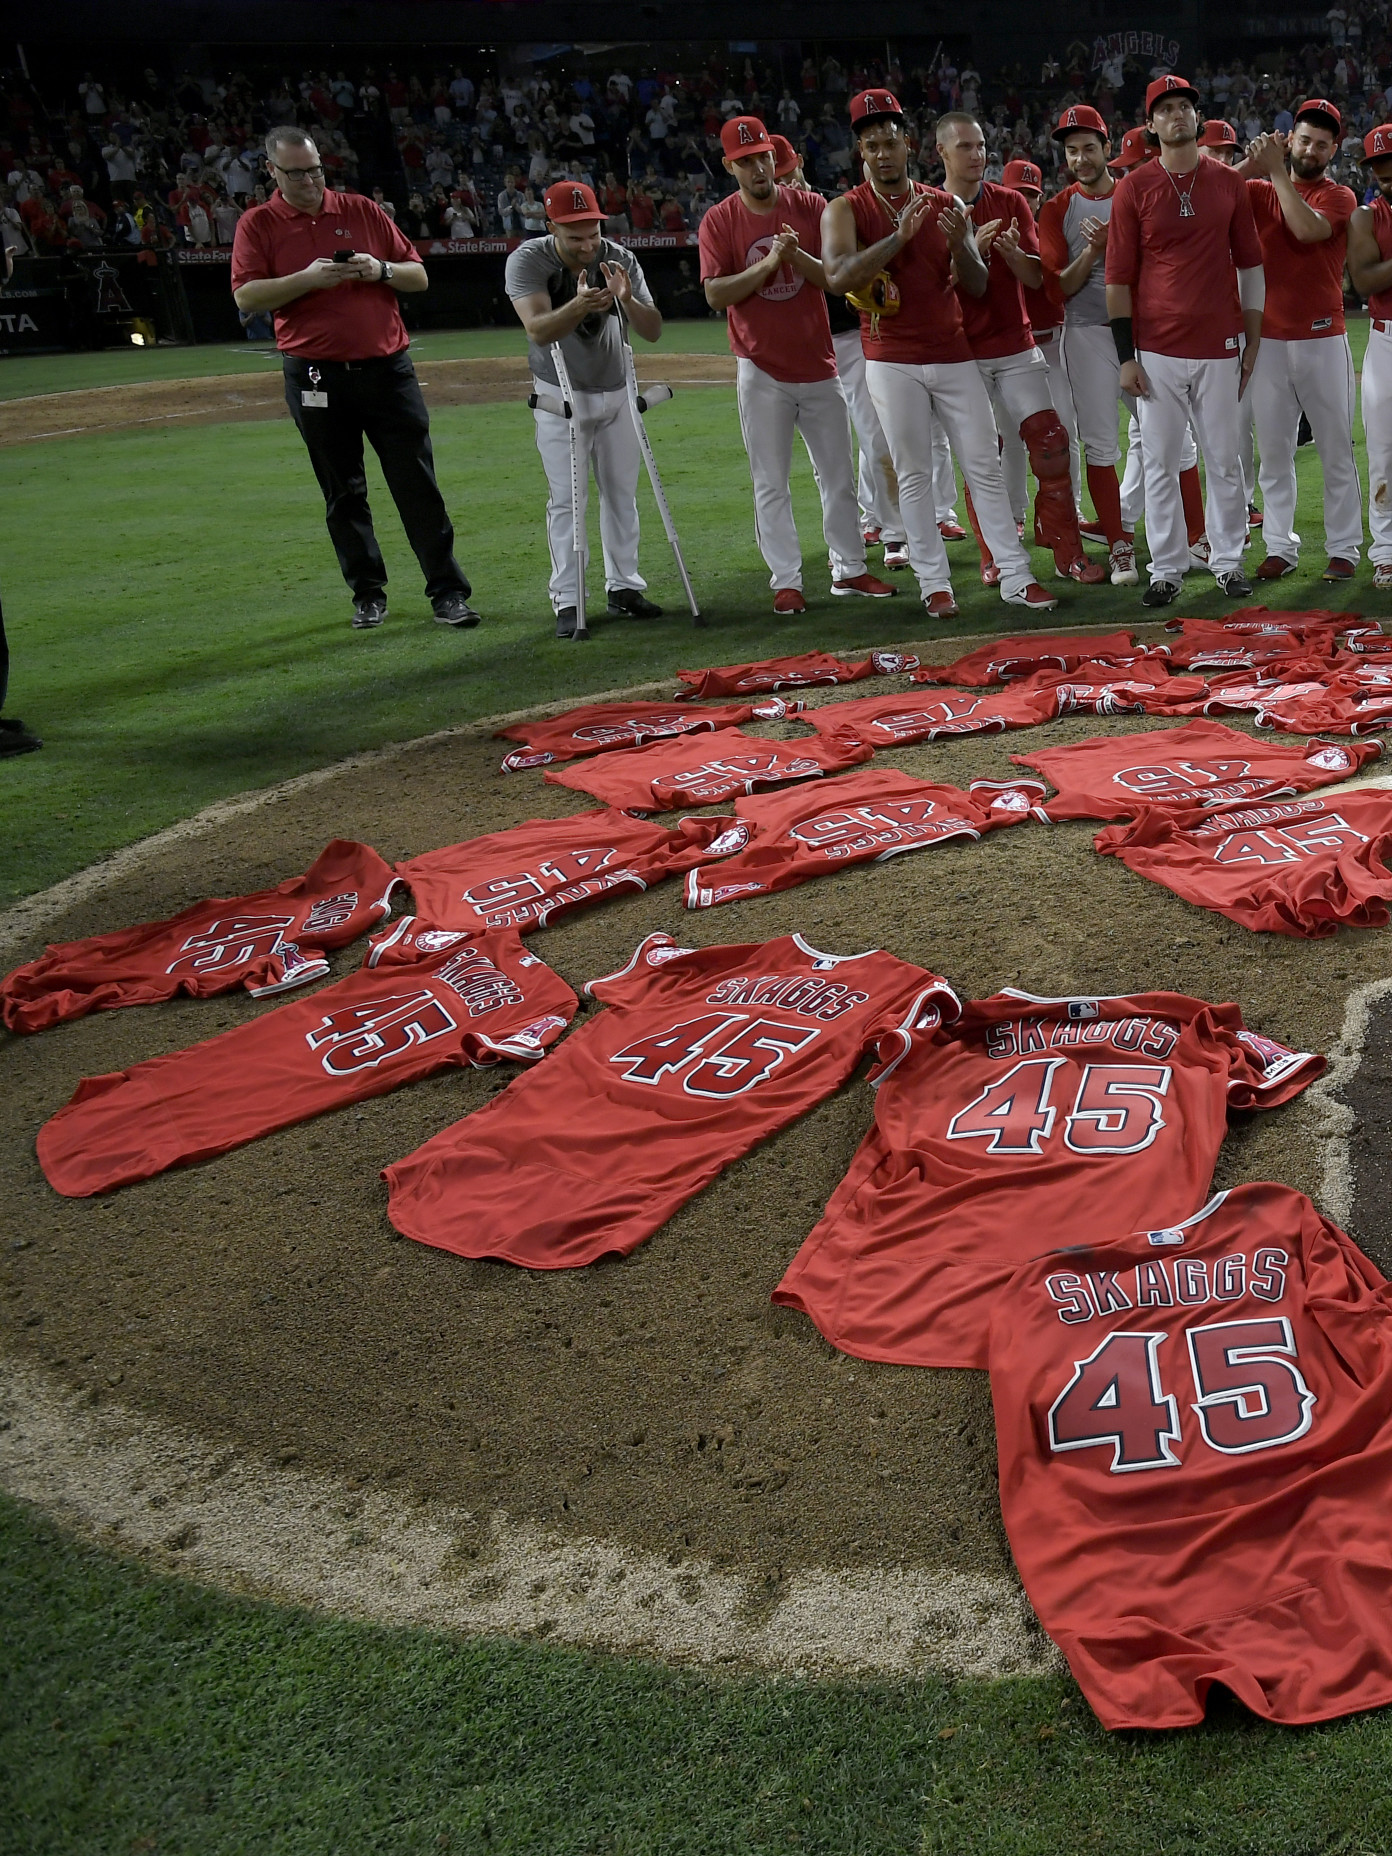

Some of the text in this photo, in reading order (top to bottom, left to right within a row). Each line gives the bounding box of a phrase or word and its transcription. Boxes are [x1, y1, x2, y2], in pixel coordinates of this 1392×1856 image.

[178, 251, 232, 265] StateFar
[448, 239, 508, 254] StateFarm
[620, 235, 677, 248] StateFarm
[762, 285, 798, 296] CANCER
[1112, 760, 1252, 794] 45
[789, 799, 937, 846] 45
[461, 848, 617, 916] 45
[165, 914, 296, 975] 45
[706, 975, 869, 1023] SKAGGS
[305, 989, 458, 1077] 45
[608, 1011, 821, 1100] 45
[985, 1016, 1182, 1061] SKAGGS
[946, 1057, 1173, 1156] 45
[1045, 1246, 1289, 1326] SKAGGS
[1047, 1316, 1318, 1474] 45
